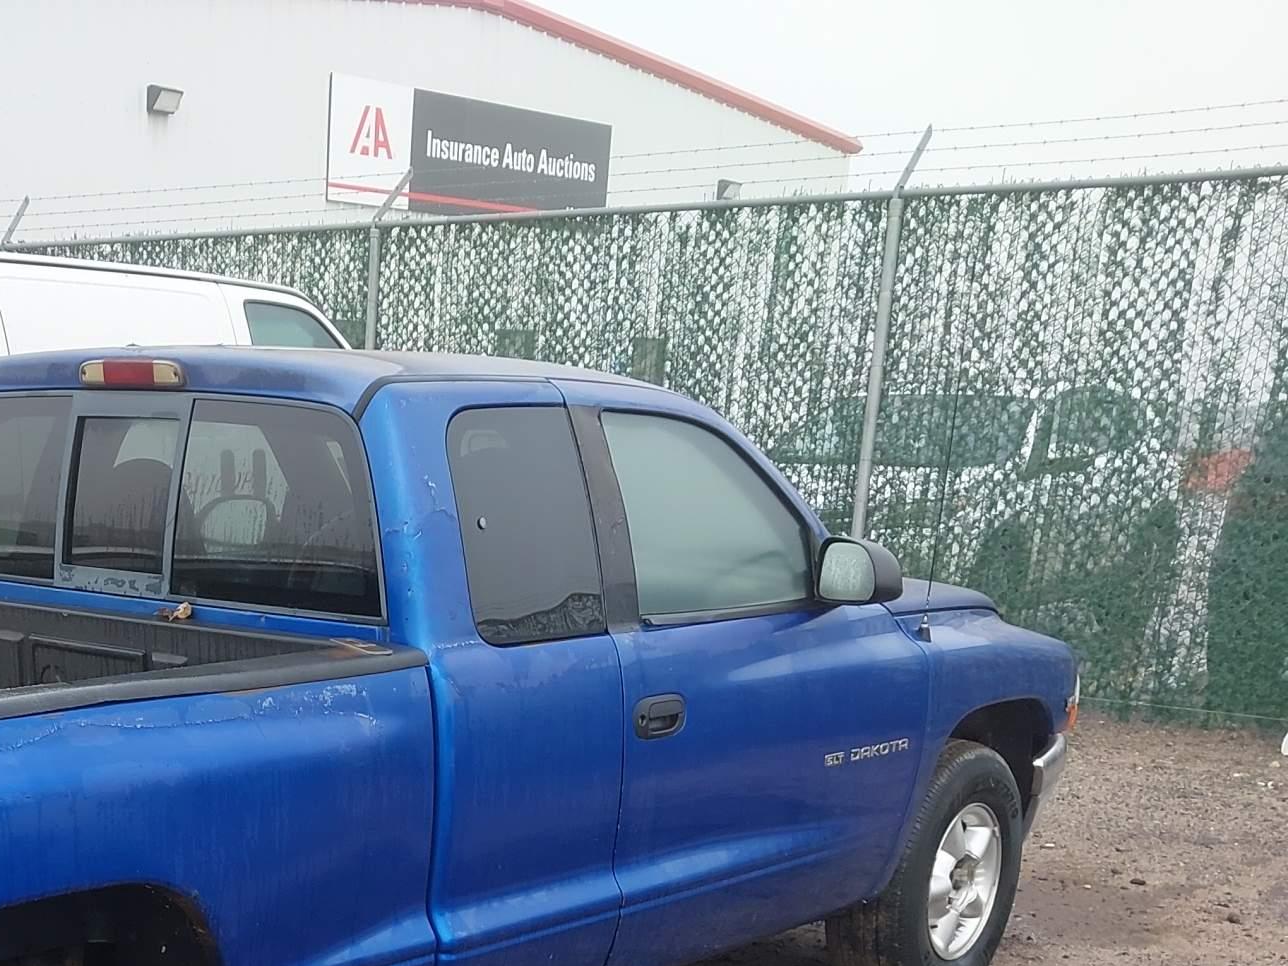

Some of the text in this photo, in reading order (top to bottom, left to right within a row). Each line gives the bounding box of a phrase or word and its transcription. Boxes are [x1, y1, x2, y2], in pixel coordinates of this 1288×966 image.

[426, 129, 596, 183] Insurance Auto Auctions
[824, 738, 909, 767] SLT DAKOTA
